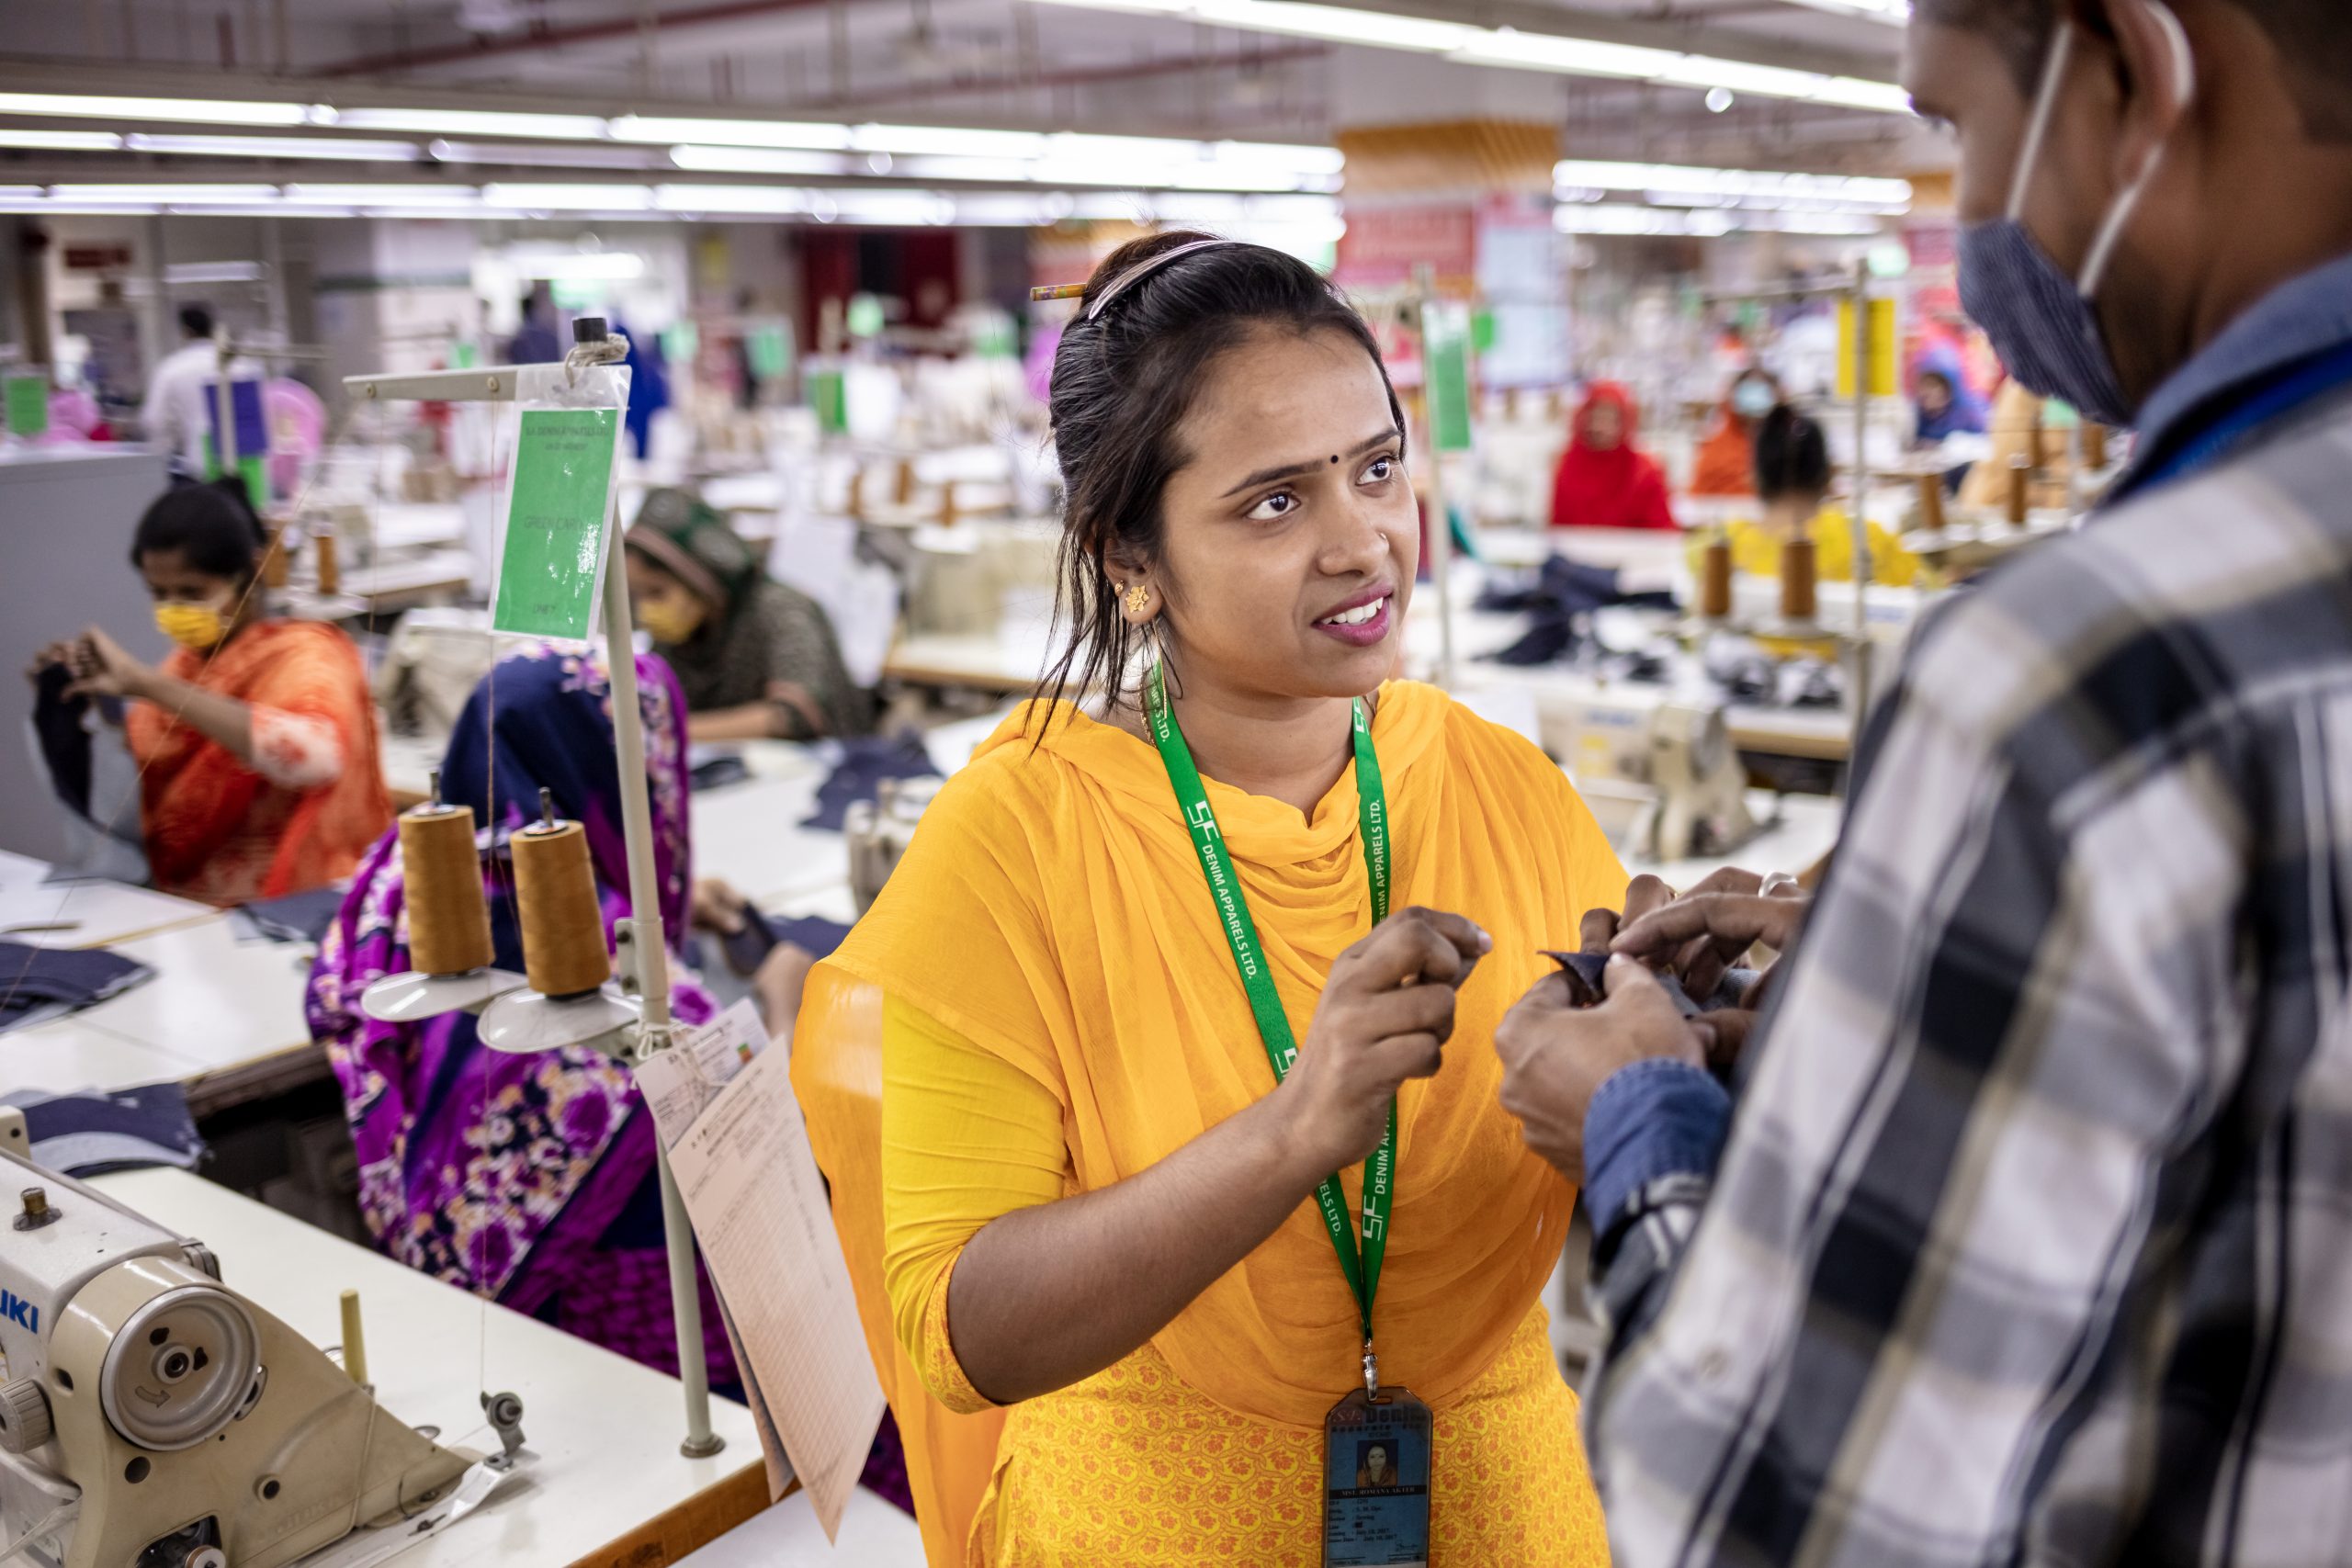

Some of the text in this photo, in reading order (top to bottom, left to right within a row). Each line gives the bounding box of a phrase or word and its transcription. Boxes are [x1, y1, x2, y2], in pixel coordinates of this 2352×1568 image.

[1370, 799, 1381, 824] LTD.
[1372, 826, 1385, 887] APPARELS
[1186, 800, 1257, 980] SF DENIM APPARELS LTD.
[1374, 1149, 1389, 1195] DENIM
[1328, 1208, 1341, 1236] LTD.
